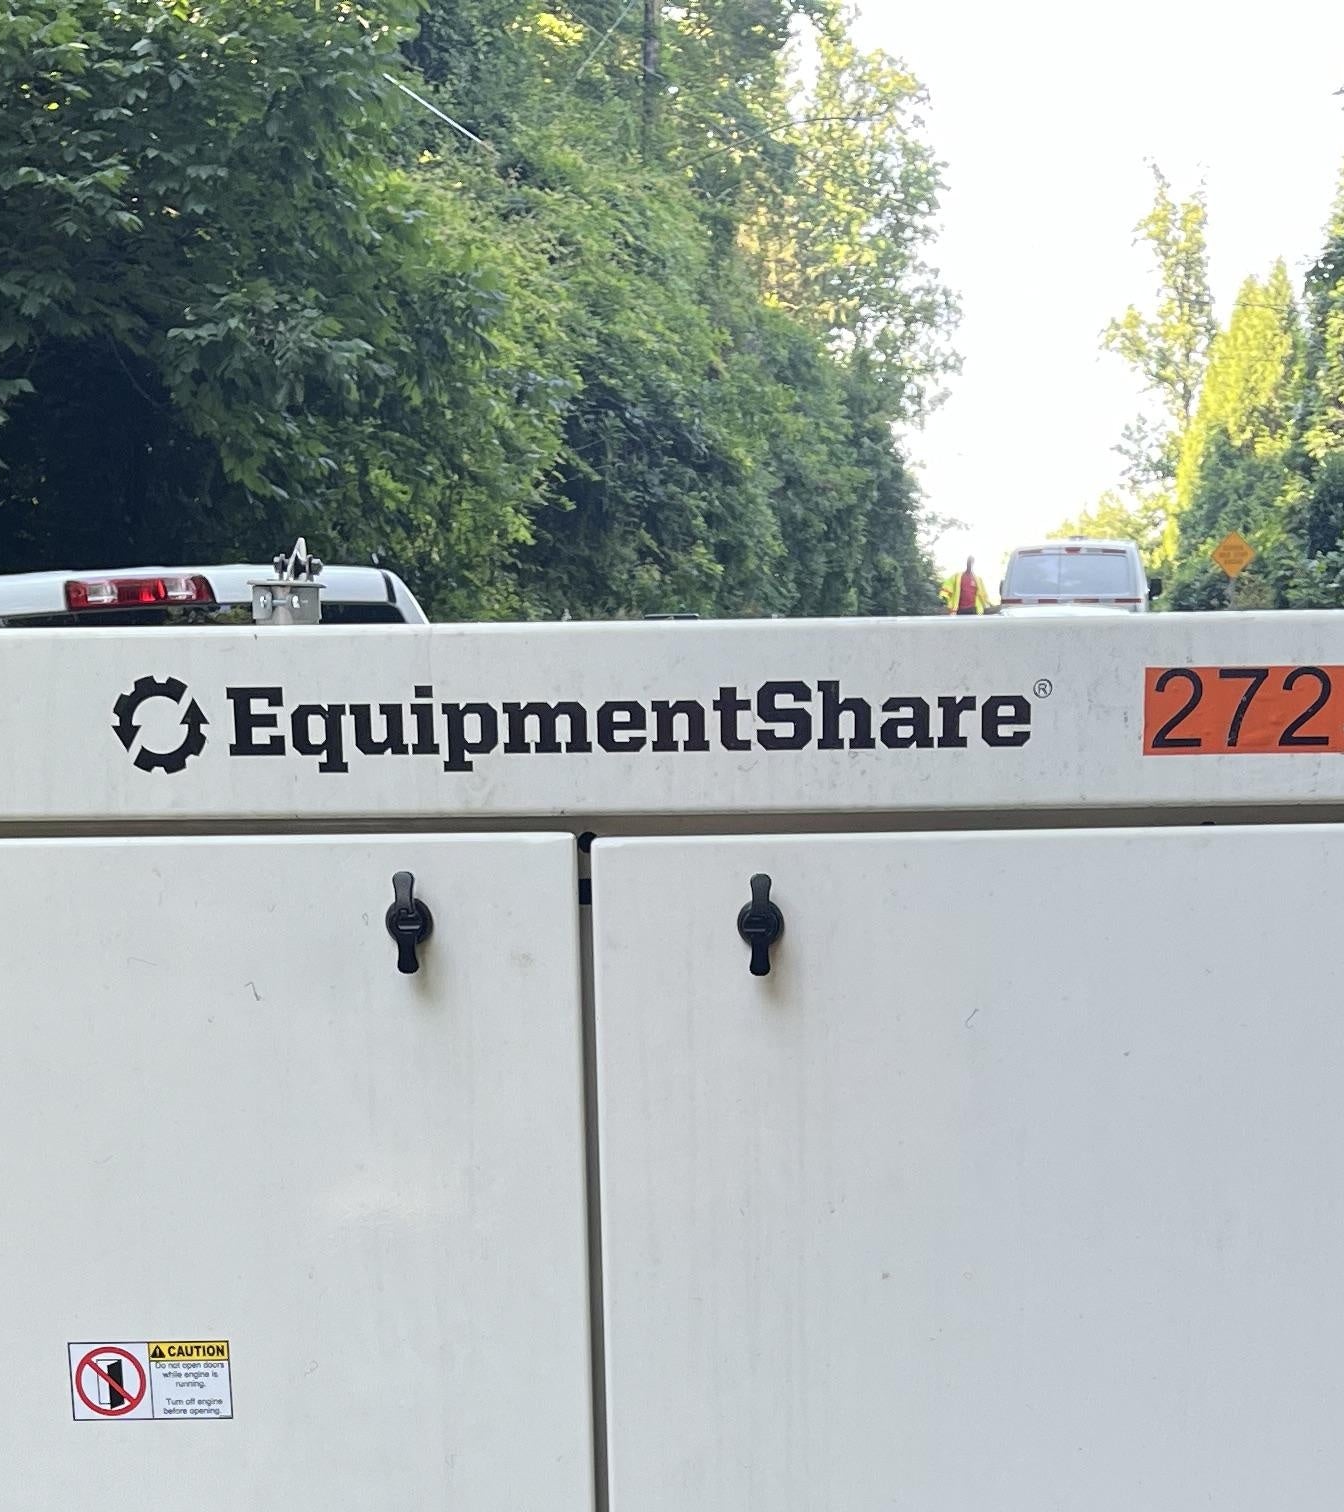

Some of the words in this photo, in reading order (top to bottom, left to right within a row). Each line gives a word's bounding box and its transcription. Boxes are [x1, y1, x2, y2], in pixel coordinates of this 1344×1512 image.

[168, 1345, 225, 1357] CAUTION
[184, 1371, 209, 1379] engine
[198, 1398, 223, 1406] engine
